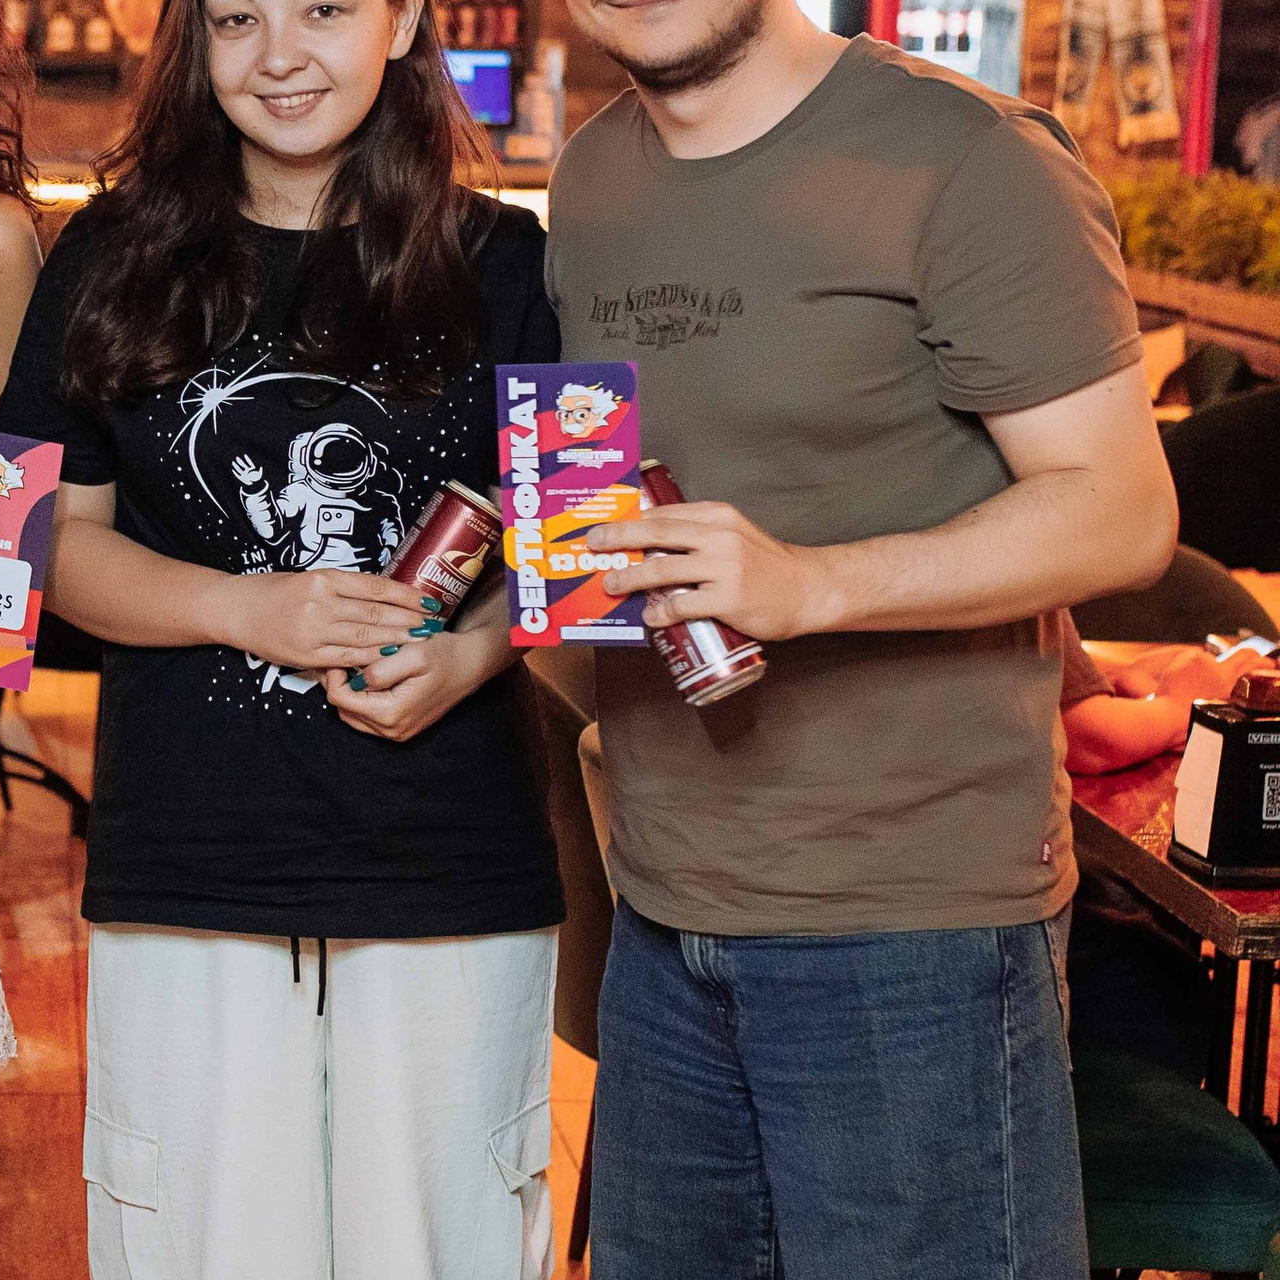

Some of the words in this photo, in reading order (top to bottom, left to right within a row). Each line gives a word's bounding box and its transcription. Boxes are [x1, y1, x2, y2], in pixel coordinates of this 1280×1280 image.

[625, 284, 700, 312] STRAUSS
[507, 377, 549, 635] СЕРТИФИКАТ
[548, 553, 577, 572] 13
[578, 552, 630, 571] 000
